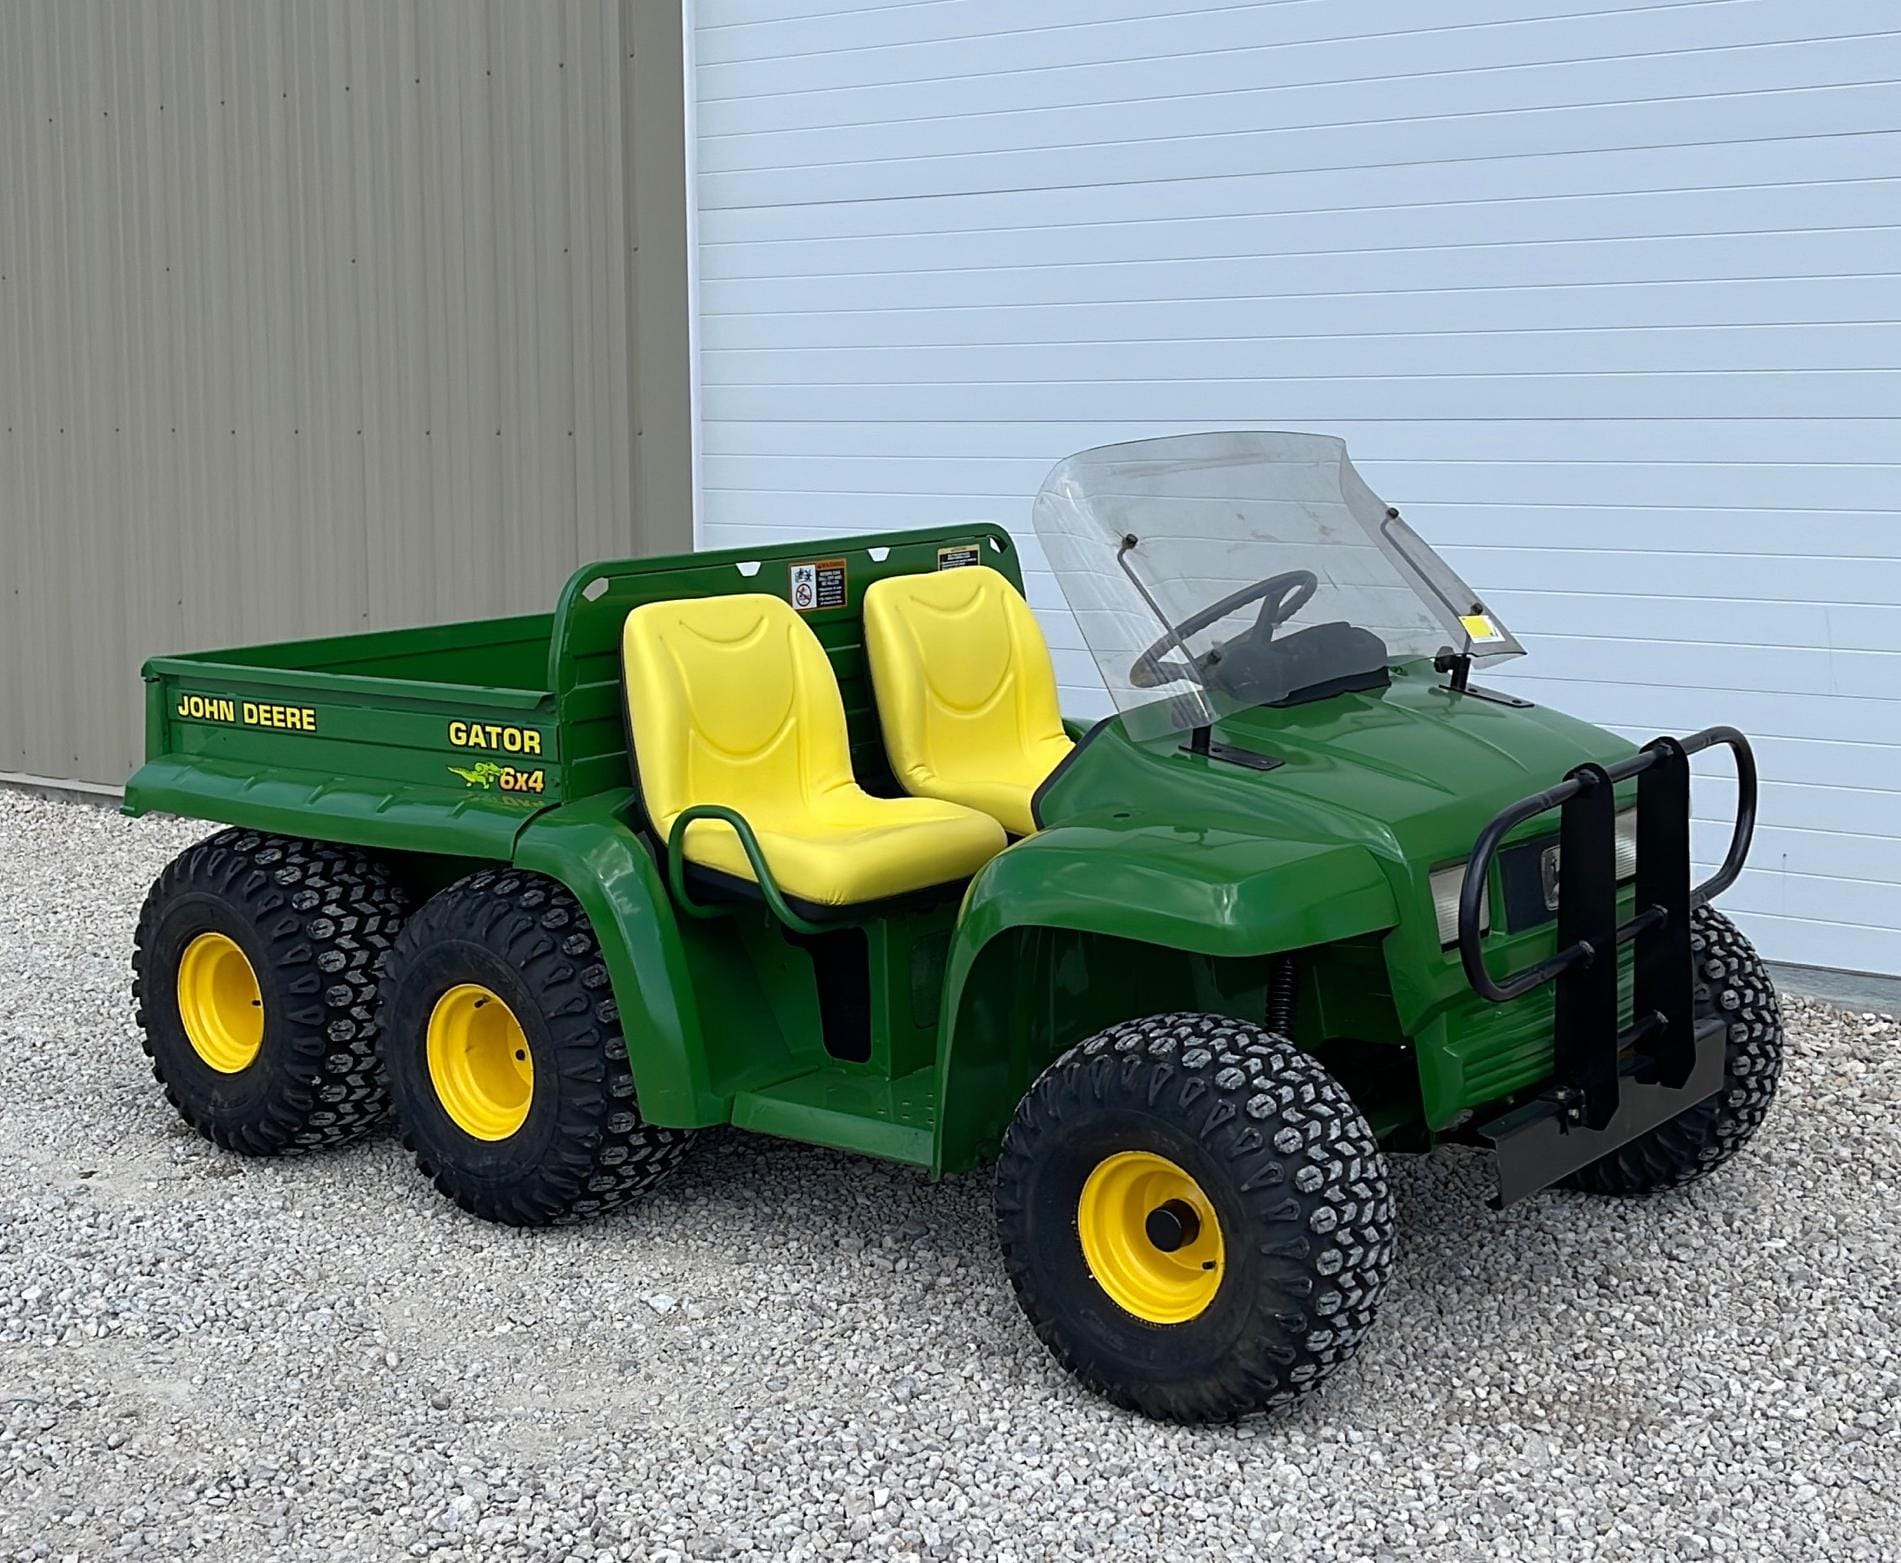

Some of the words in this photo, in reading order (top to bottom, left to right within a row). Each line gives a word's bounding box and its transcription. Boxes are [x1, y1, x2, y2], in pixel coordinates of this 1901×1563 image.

[178, 695, 235, 722] JOHN
[242, 702, 316, 731] DEERE
[449, 721, 541, 754] GATOR
[500, 766, 544, 793] 6x4
